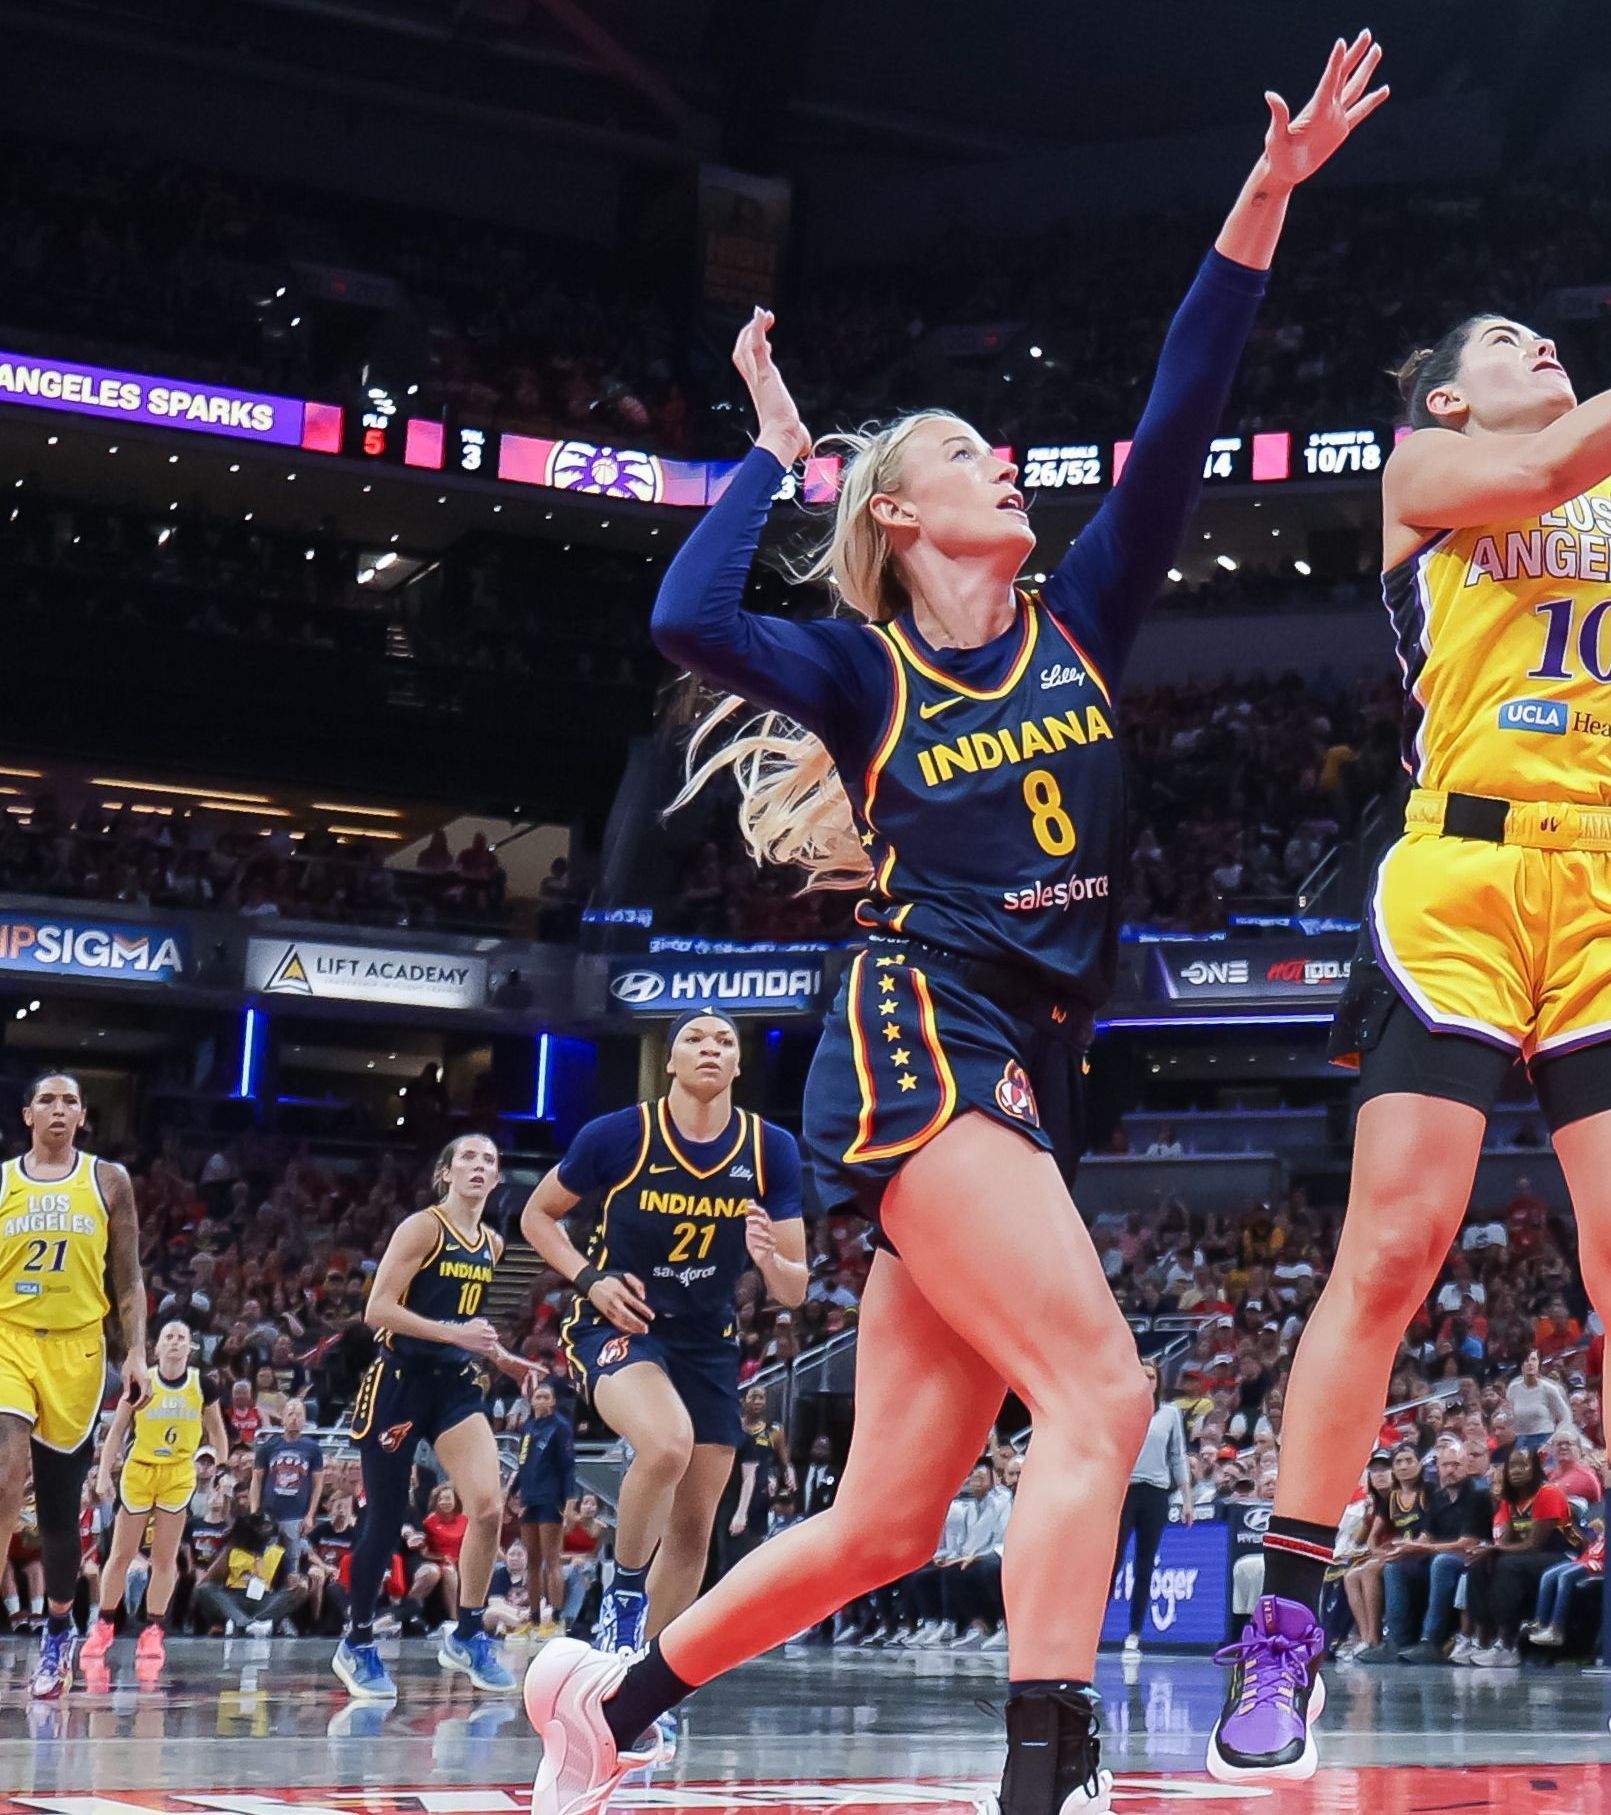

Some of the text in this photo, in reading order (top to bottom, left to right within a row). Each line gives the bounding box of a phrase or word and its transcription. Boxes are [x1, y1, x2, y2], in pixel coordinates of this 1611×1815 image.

[0, 363, 274, 431] ANGELES SPARKS
[364, 429, 385, 455] 5
[461, 444, 481, 470] 3
[1304, 444, 1381, 473] 10/18
[1024, 459, 1101, 487] 26/52
[1040, 664, 1086, 690] Lilly
[1507, 705, 1560, 727] UCLA
[917, 705, 1114, 787] INDIANA
[1023, 769, 1076, 857] 8
[1003, 873, 1109, 911] salesforce
[317, 957, 469, 985] LIFT ACADEMY
[671, 969, 822, 998] HYUNDAI
[28, 1194, 72, 1213] LOS
[639, 1190, 751, 1218] INDIANA
[4, 1211, 95, 1237] ANGELES
[24, 1239, 68, 1273] 21
[668, 1222, 716, 1262] 21
[439, 1261, 492, 1283] INDIAN
[458, 1281, 482, 1316] 10
[164, 1426, 178, 1445] 6
[1125, 1553, 1198, 1631] oger
